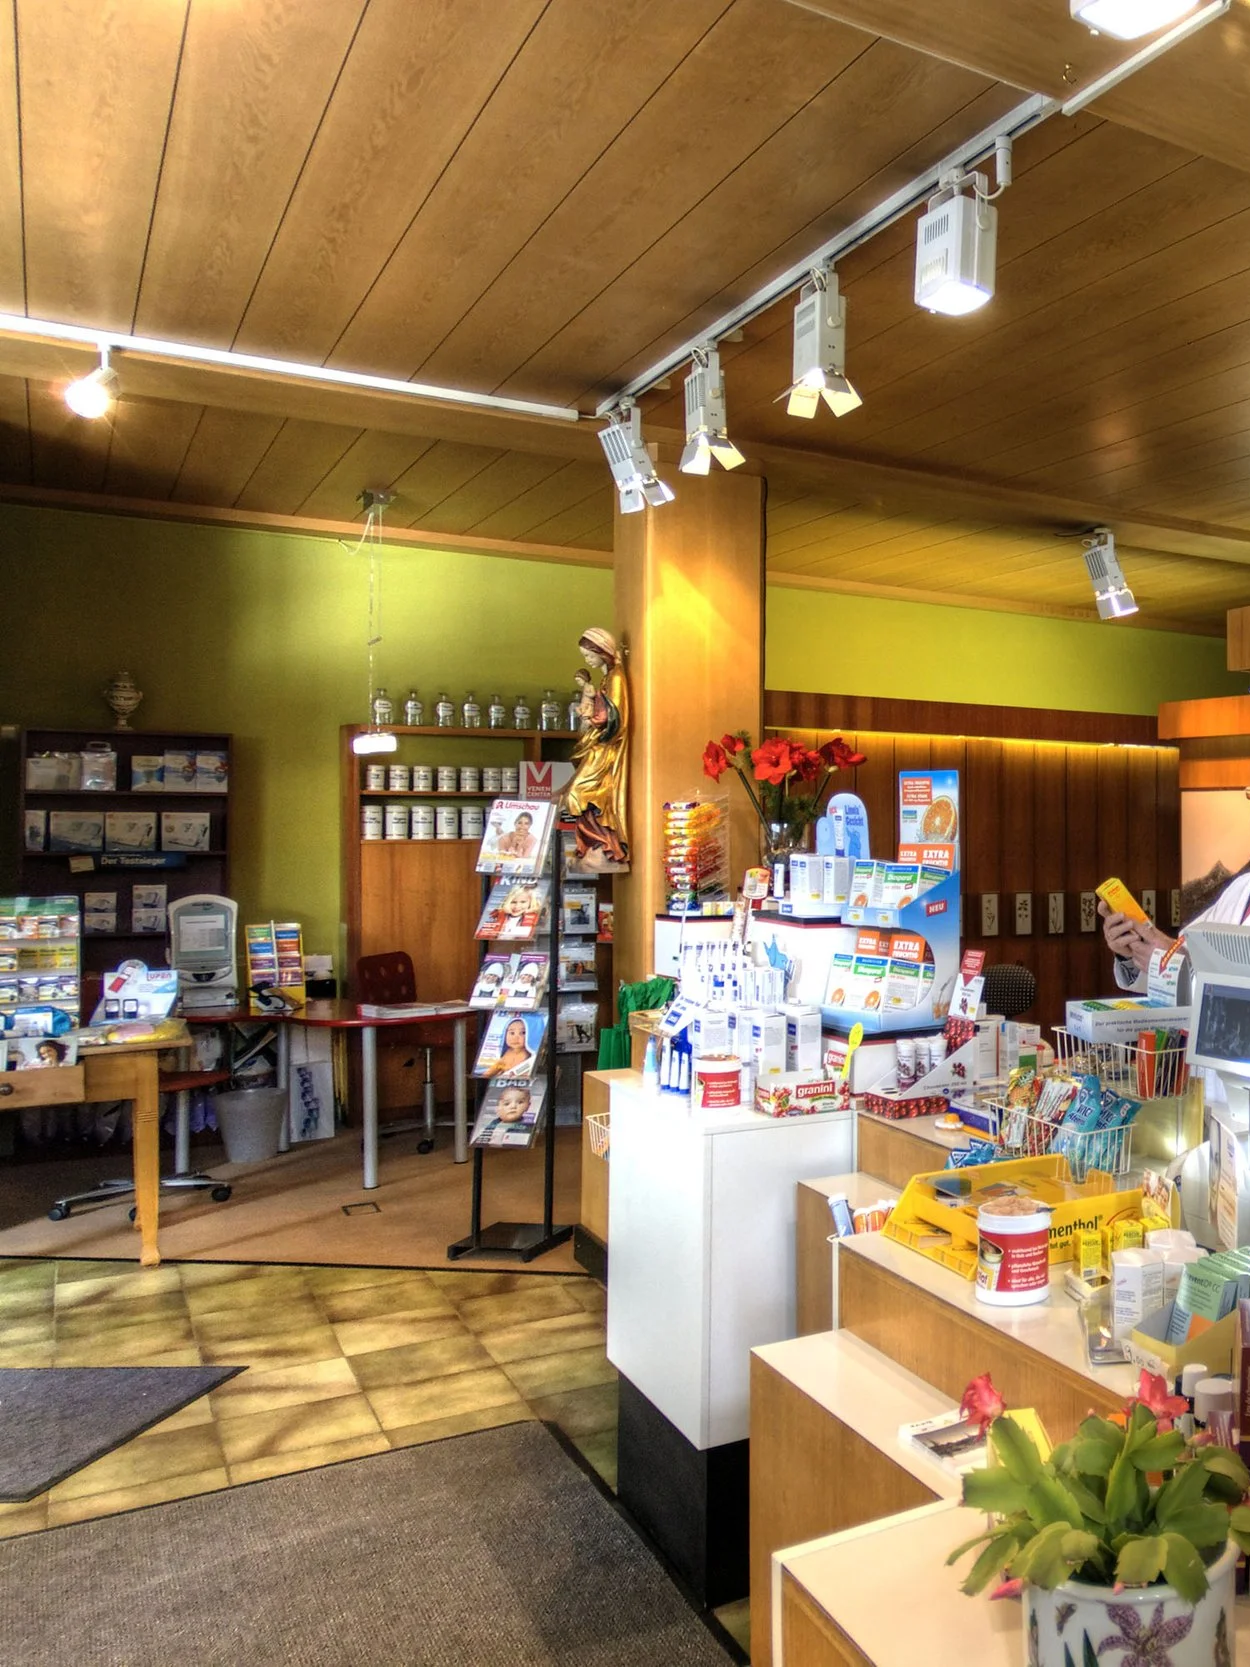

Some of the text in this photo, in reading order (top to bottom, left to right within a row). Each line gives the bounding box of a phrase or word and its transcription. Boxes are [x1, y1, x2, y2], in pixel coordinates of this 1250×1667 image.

[505, 802, 539, 810] Umschau
[923, 850, 949, 859] EXTRA
[102, 856, 118, 864] Der
[929, 903, 944, 913] NEU
[859, 937, 876, 945] EXTRA
[894, 940, 920, 950] EXTRA
[797, 1083, 833, 1096] granini
[1212, 1283, 1220, 1294] CC
